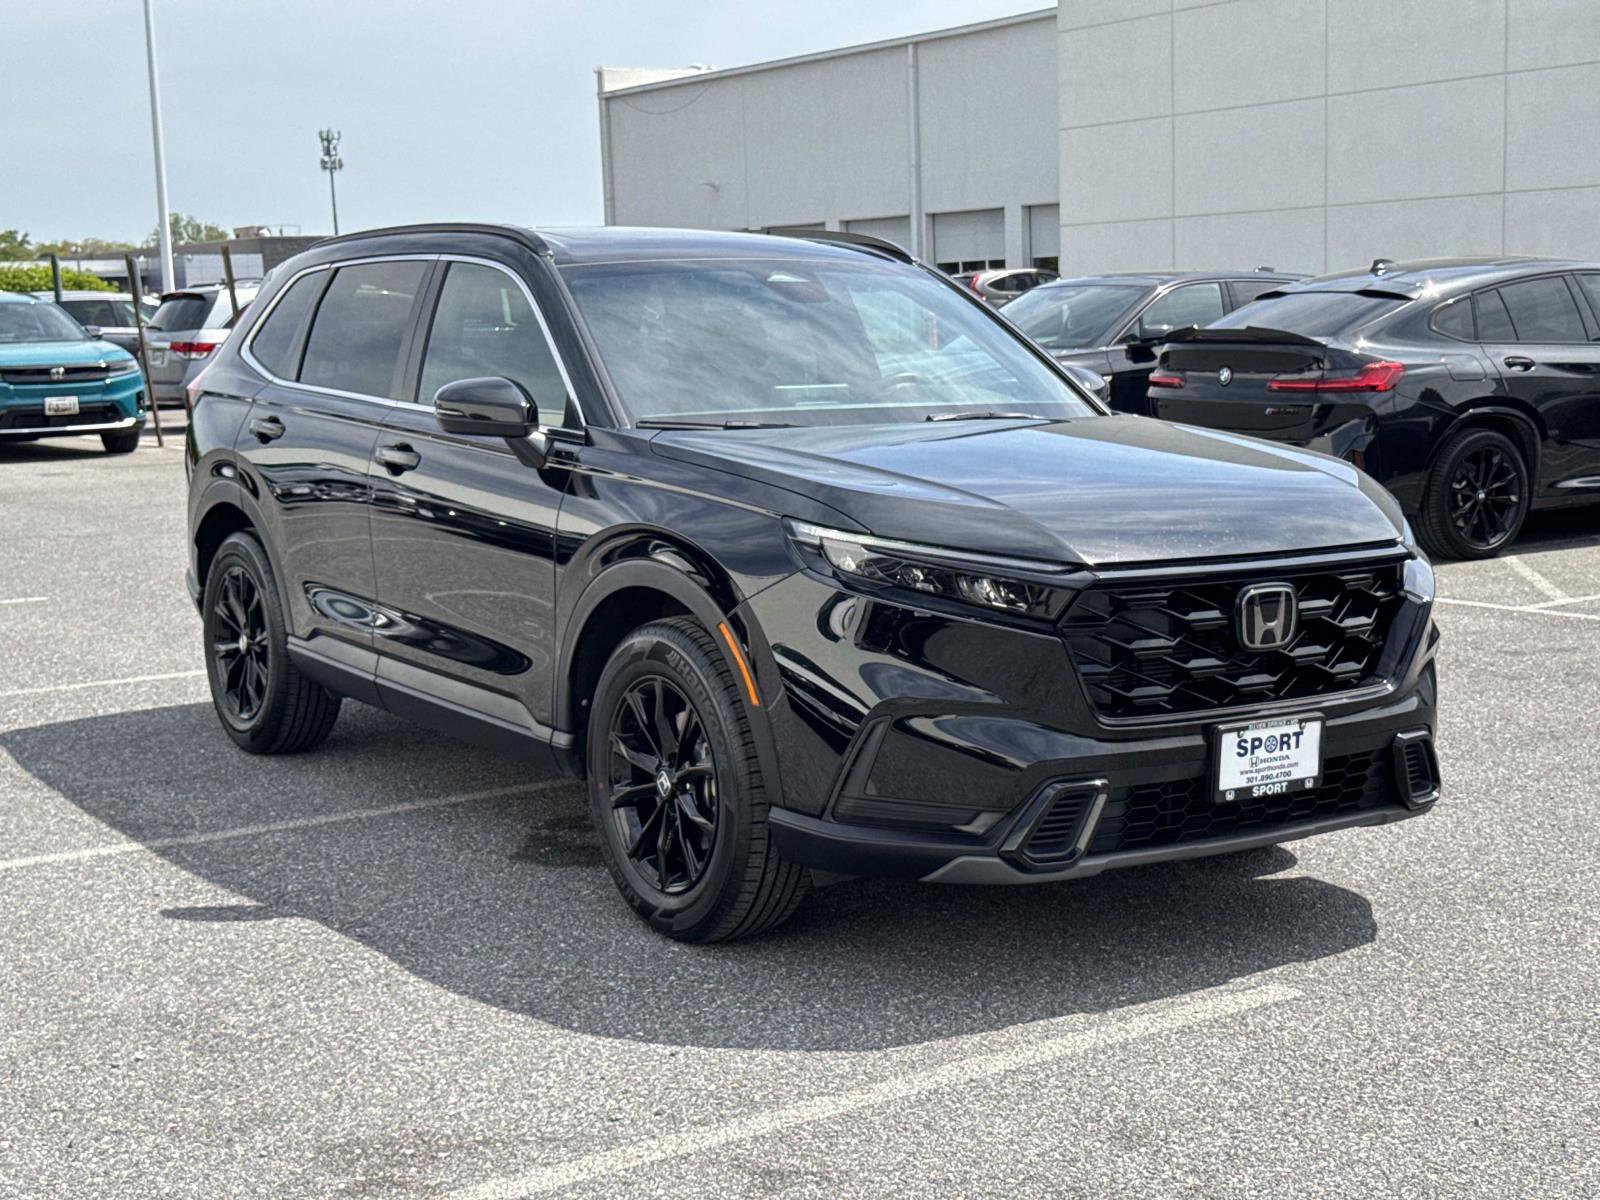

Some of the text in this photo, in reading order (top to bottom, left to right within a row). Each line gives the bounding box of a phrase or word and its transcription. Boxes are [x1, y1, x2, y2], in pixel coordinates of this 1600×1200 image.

[1236, 731, 1303, 757] SPORT
[1260, 754, 1290, 764] HONDA
[1240, 762, 1298, 775] www.sporthonda.com
[1246, 770, 1291, 784] 301.890.4700
[1252, 782, 1288, 797] SPORT
